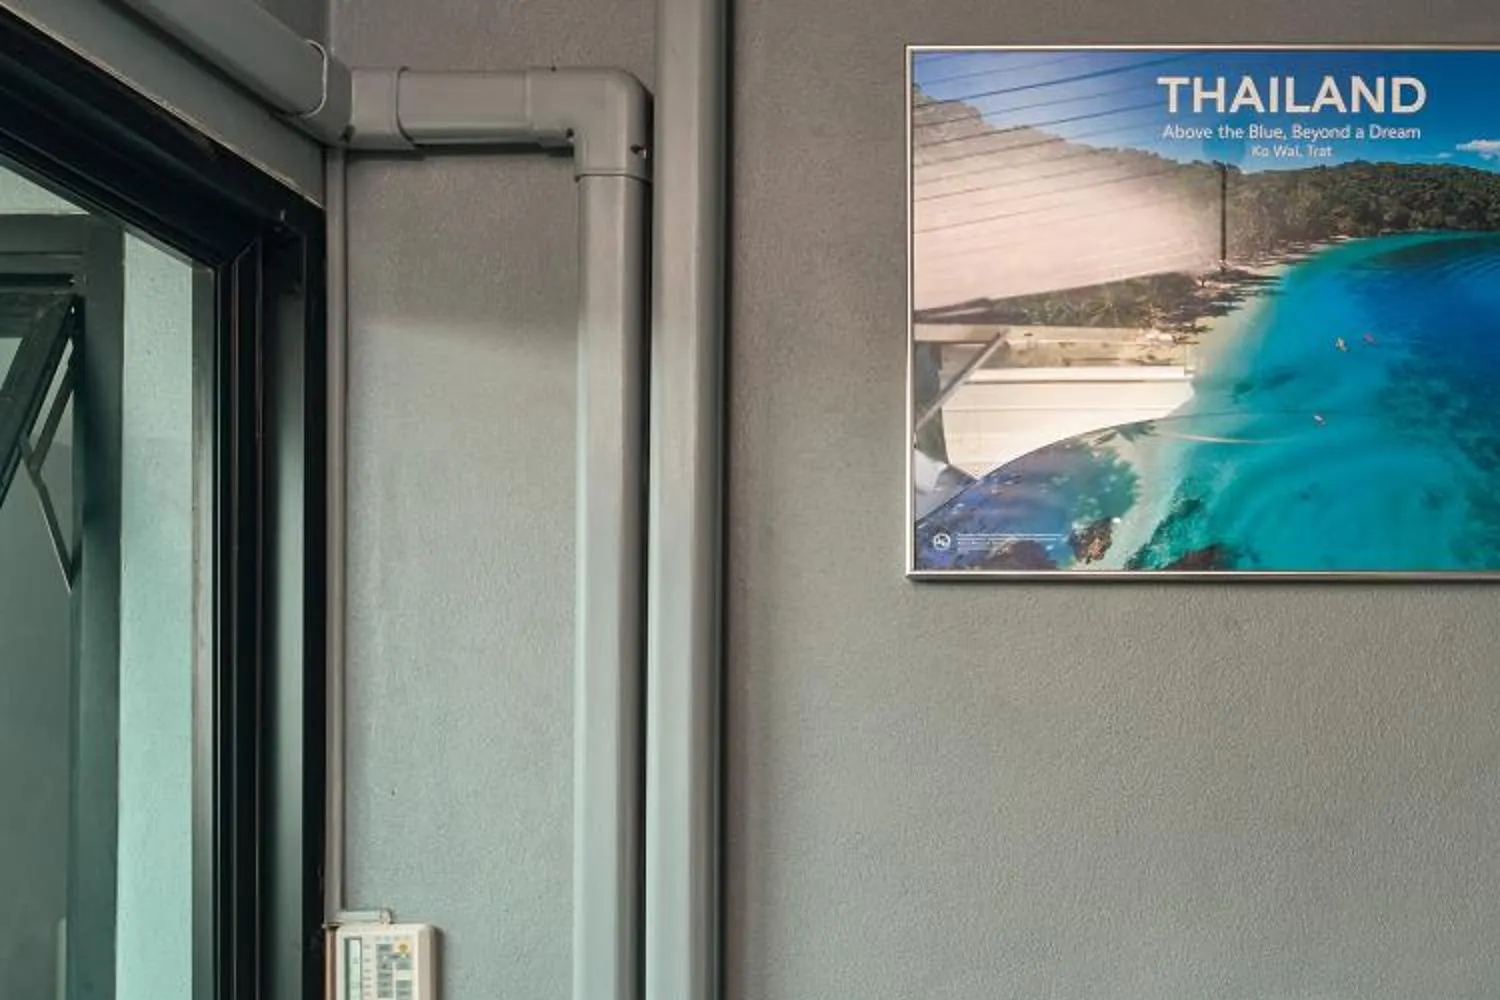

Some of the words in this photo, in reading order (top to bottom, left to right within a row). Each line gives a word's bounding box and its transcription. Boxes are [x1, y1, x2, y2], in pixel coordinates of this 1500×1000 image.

[1156, 75, 1427, 114] THAILAND
[1163, 123, 1213, 139] Above
[1218, 123, 1244, 139] the
[1249, 123, 1287, 141] Blue,
[1292, 123, 1350, 143] Beyond
[1355, 128, 1365, 139] a
[1369, 123, 1421, 139] Dream
[1251, 145, 1269, 157] Ko
[1307, 145, 1332, 157] Trat
